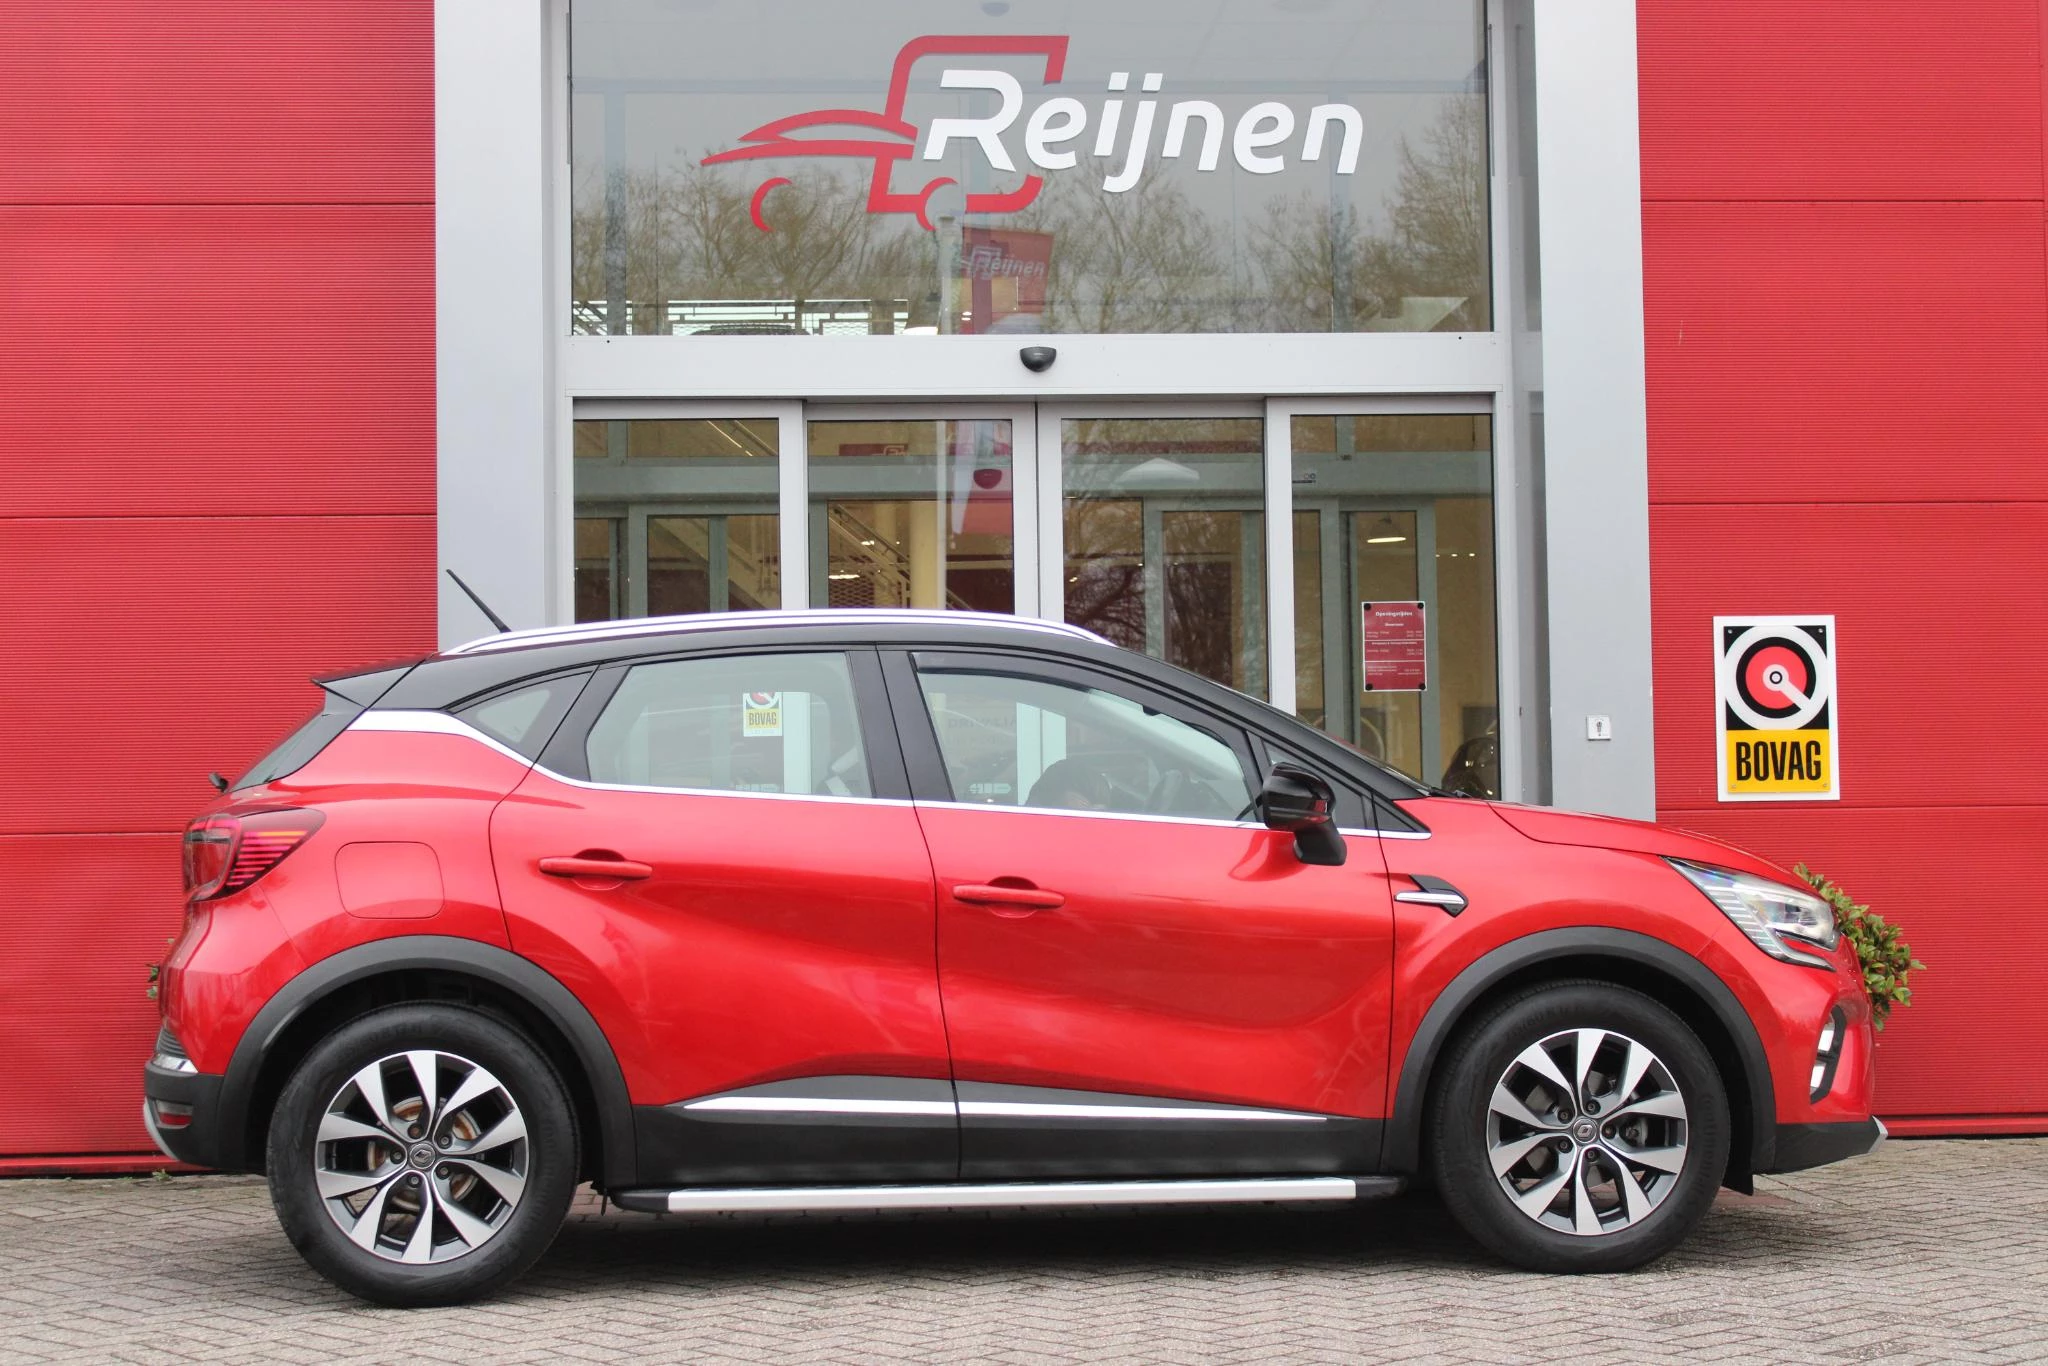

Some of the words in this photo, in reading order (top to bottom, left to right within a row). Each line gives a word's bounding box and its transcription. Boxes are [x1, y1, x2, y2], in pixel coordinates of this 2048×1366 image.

[923, 69, 1364, 193] Reijnen
[749, 712, 777, 726] BOVAG
[1735, 740, 1822, 781] BOVAG
